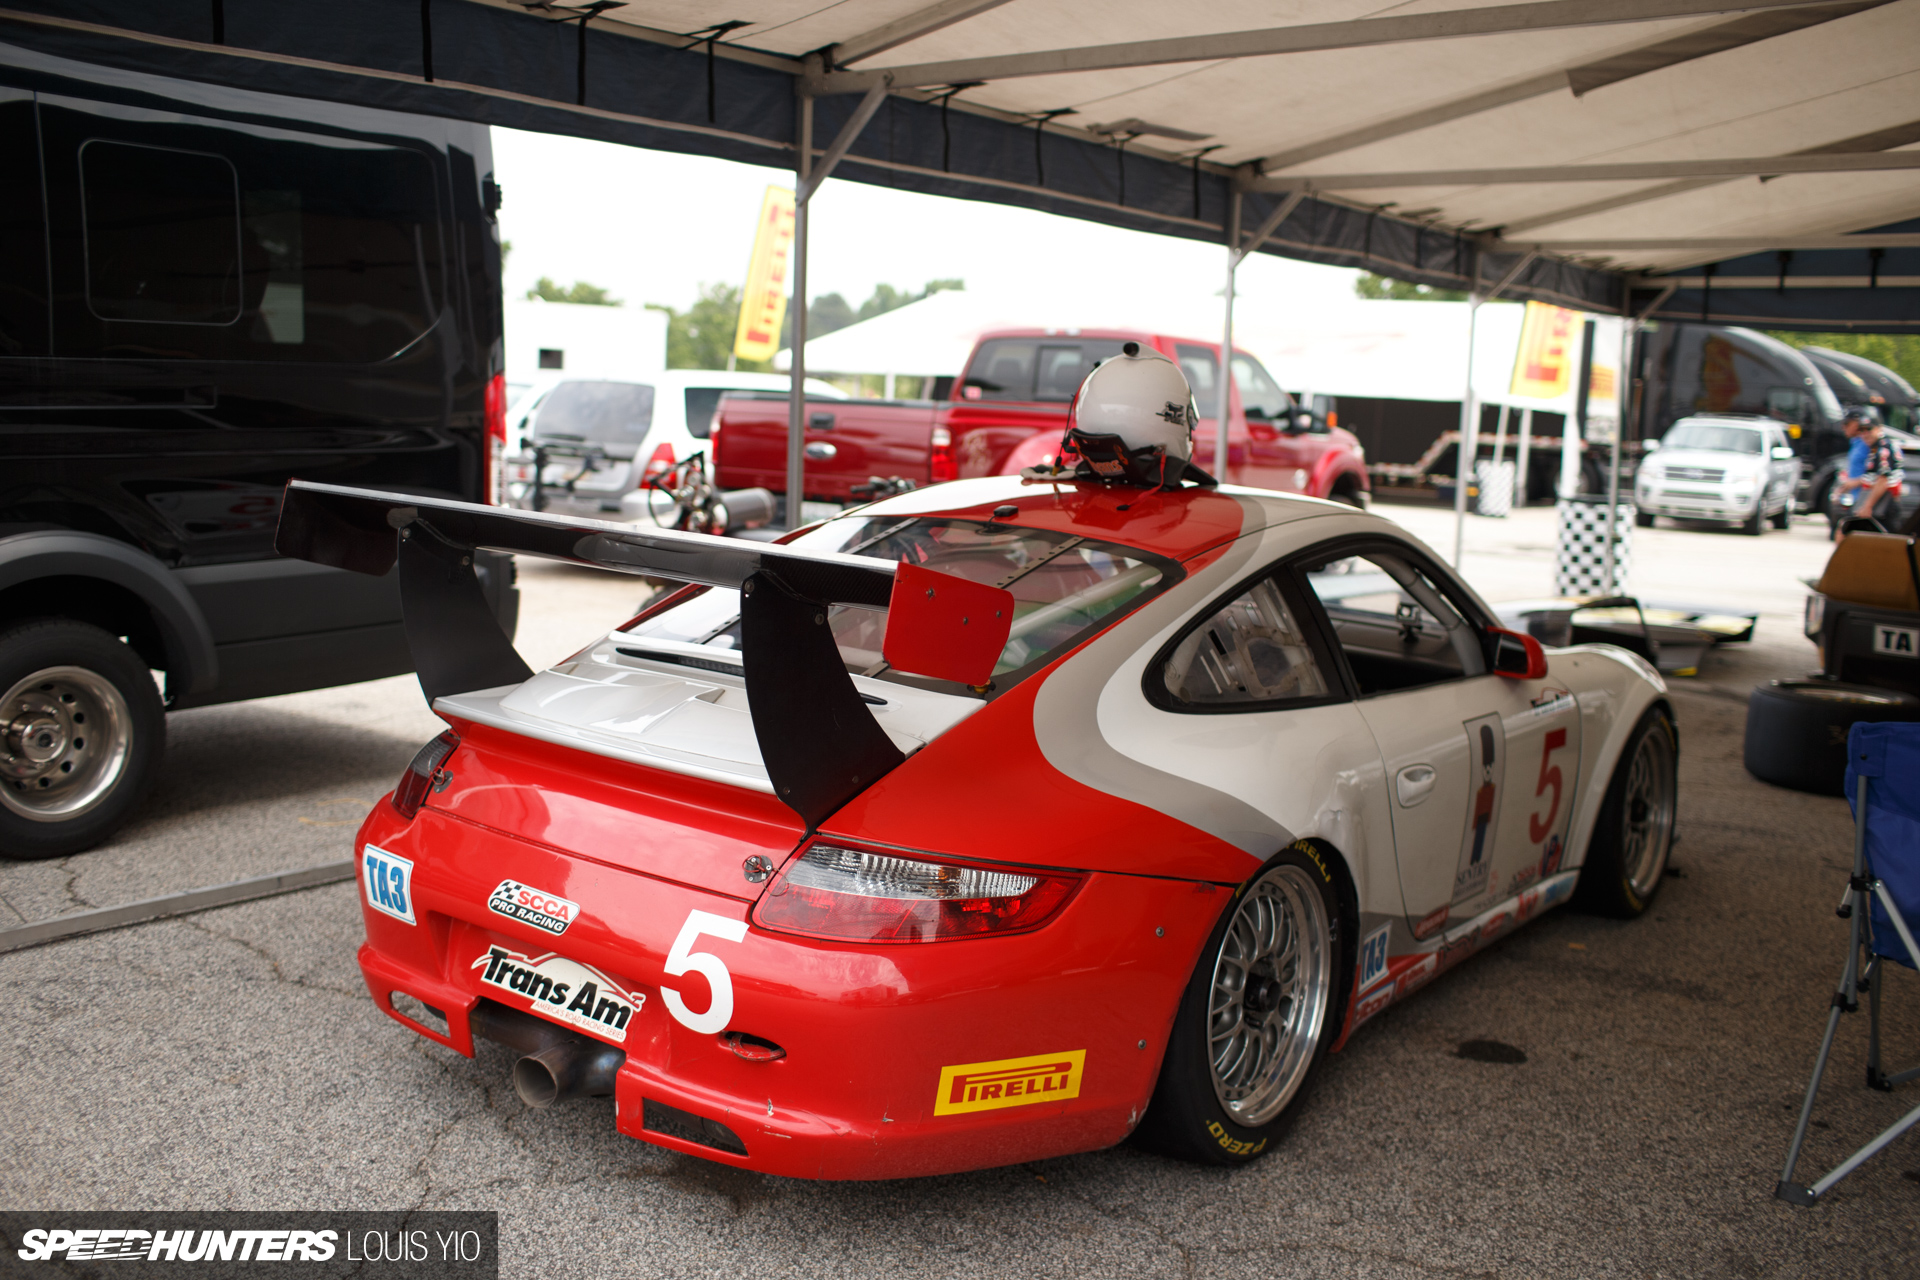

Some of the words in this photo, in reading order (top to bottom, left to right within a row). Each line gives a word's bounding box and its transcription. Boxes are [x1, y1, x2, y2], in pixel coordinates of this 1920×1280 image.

[1882, 630, 1912, 652] TA
[1529, 727, 1567, 844] 5
[366, 854, 407, 914] TA3
[518, 891, 569, 921] SCCA
[491, 898, 516, 914] PRO
[516, 907, 565, 932] RACING
[660, 908, 750, 1034] 5
[1361, 931, 1388, 985] TA3
[484, 947, 571, 1005] Trans
[566, 981, 631, 1030] Am
[535, 1001, 565, 1018] AMERICA'S
[564, 1010, 581, 1025] ROAD
[581, 1016, 605, 1032] RACING
[605, 1023, 625, 1040] SERIES
[949, 1061, 1073, 1105] PIRELLI
